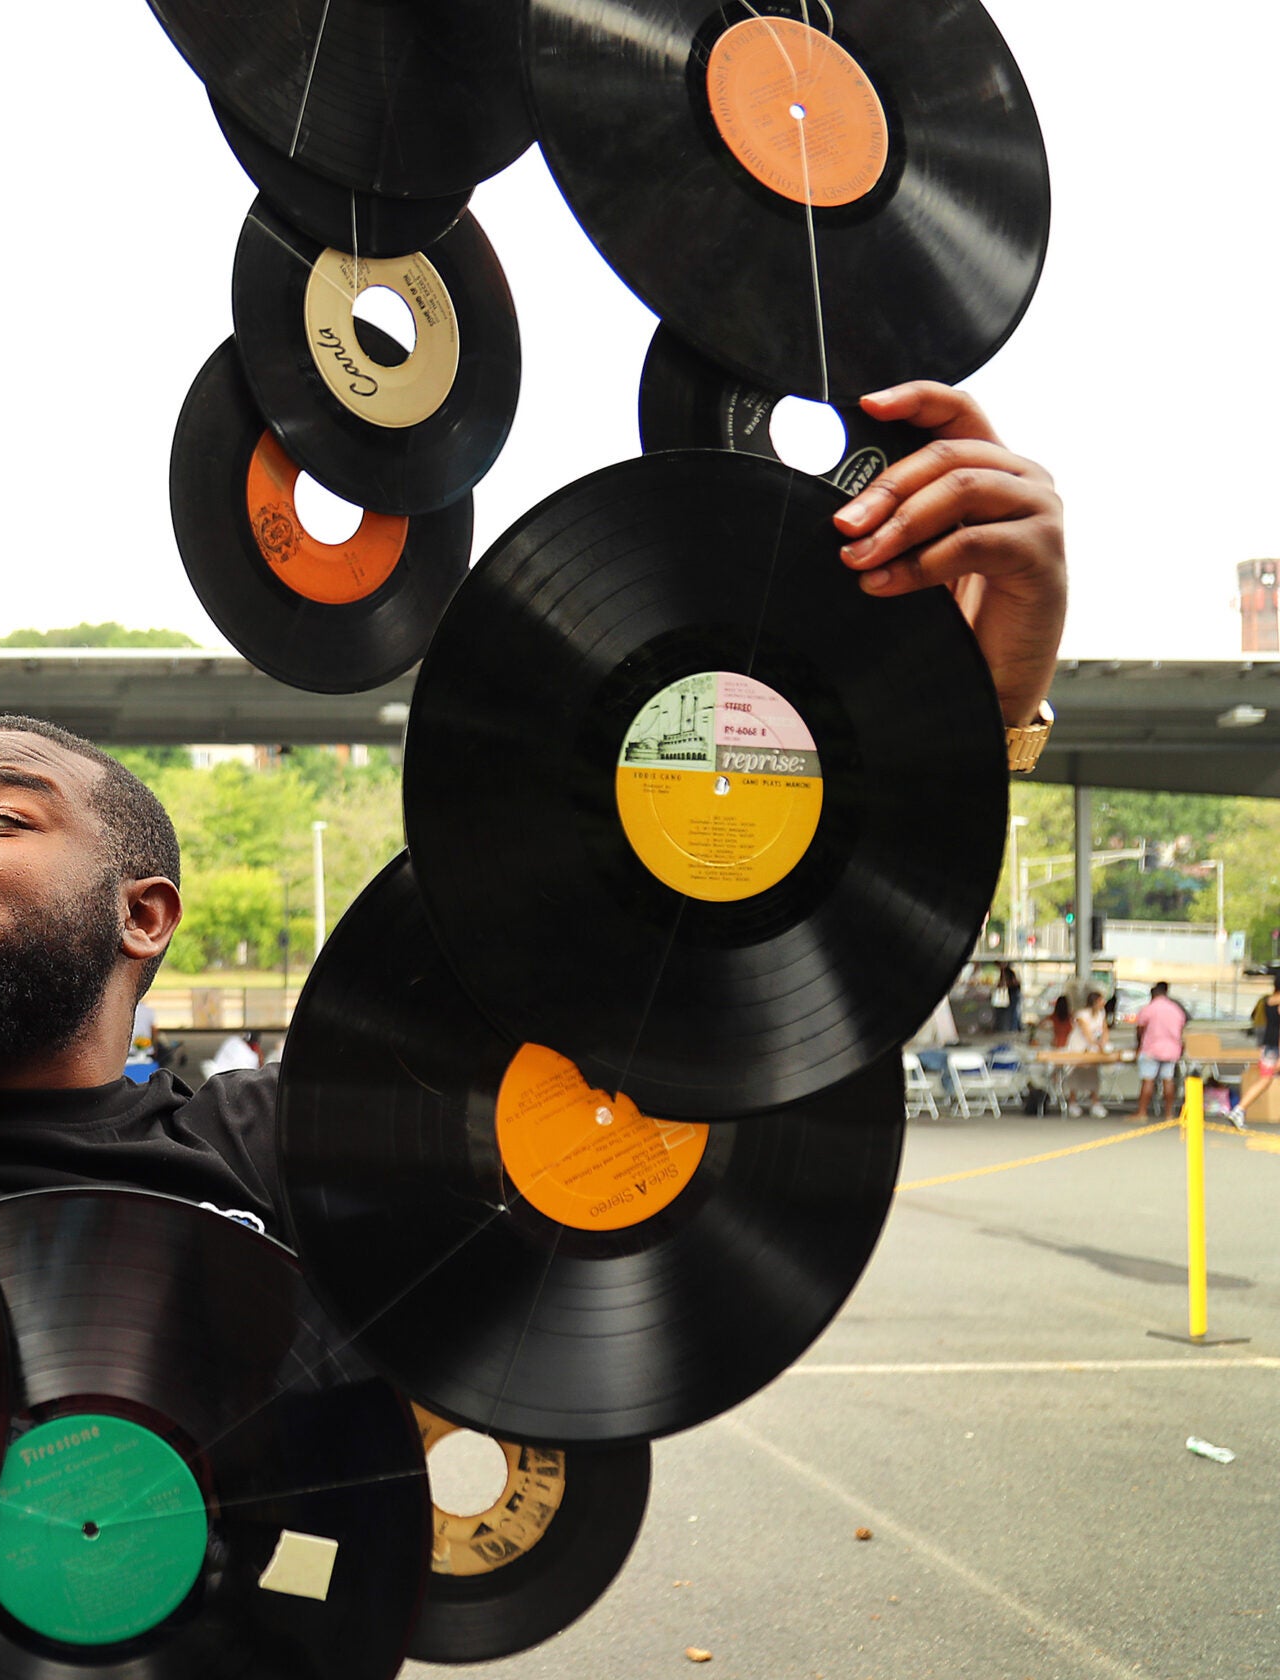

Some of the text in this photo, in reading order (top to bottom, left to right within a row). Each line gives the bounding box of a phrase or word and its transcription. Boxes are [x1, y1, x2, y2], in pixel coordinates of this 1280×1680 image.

[724, 701, 753, 713] STEREO
[648, 1163, 680, 1185] Side
[635, 1180, 647, 1195] A
[589, 1187, 635, 1218] Stereo
[20, 1425, 100, 1467] Firestone
